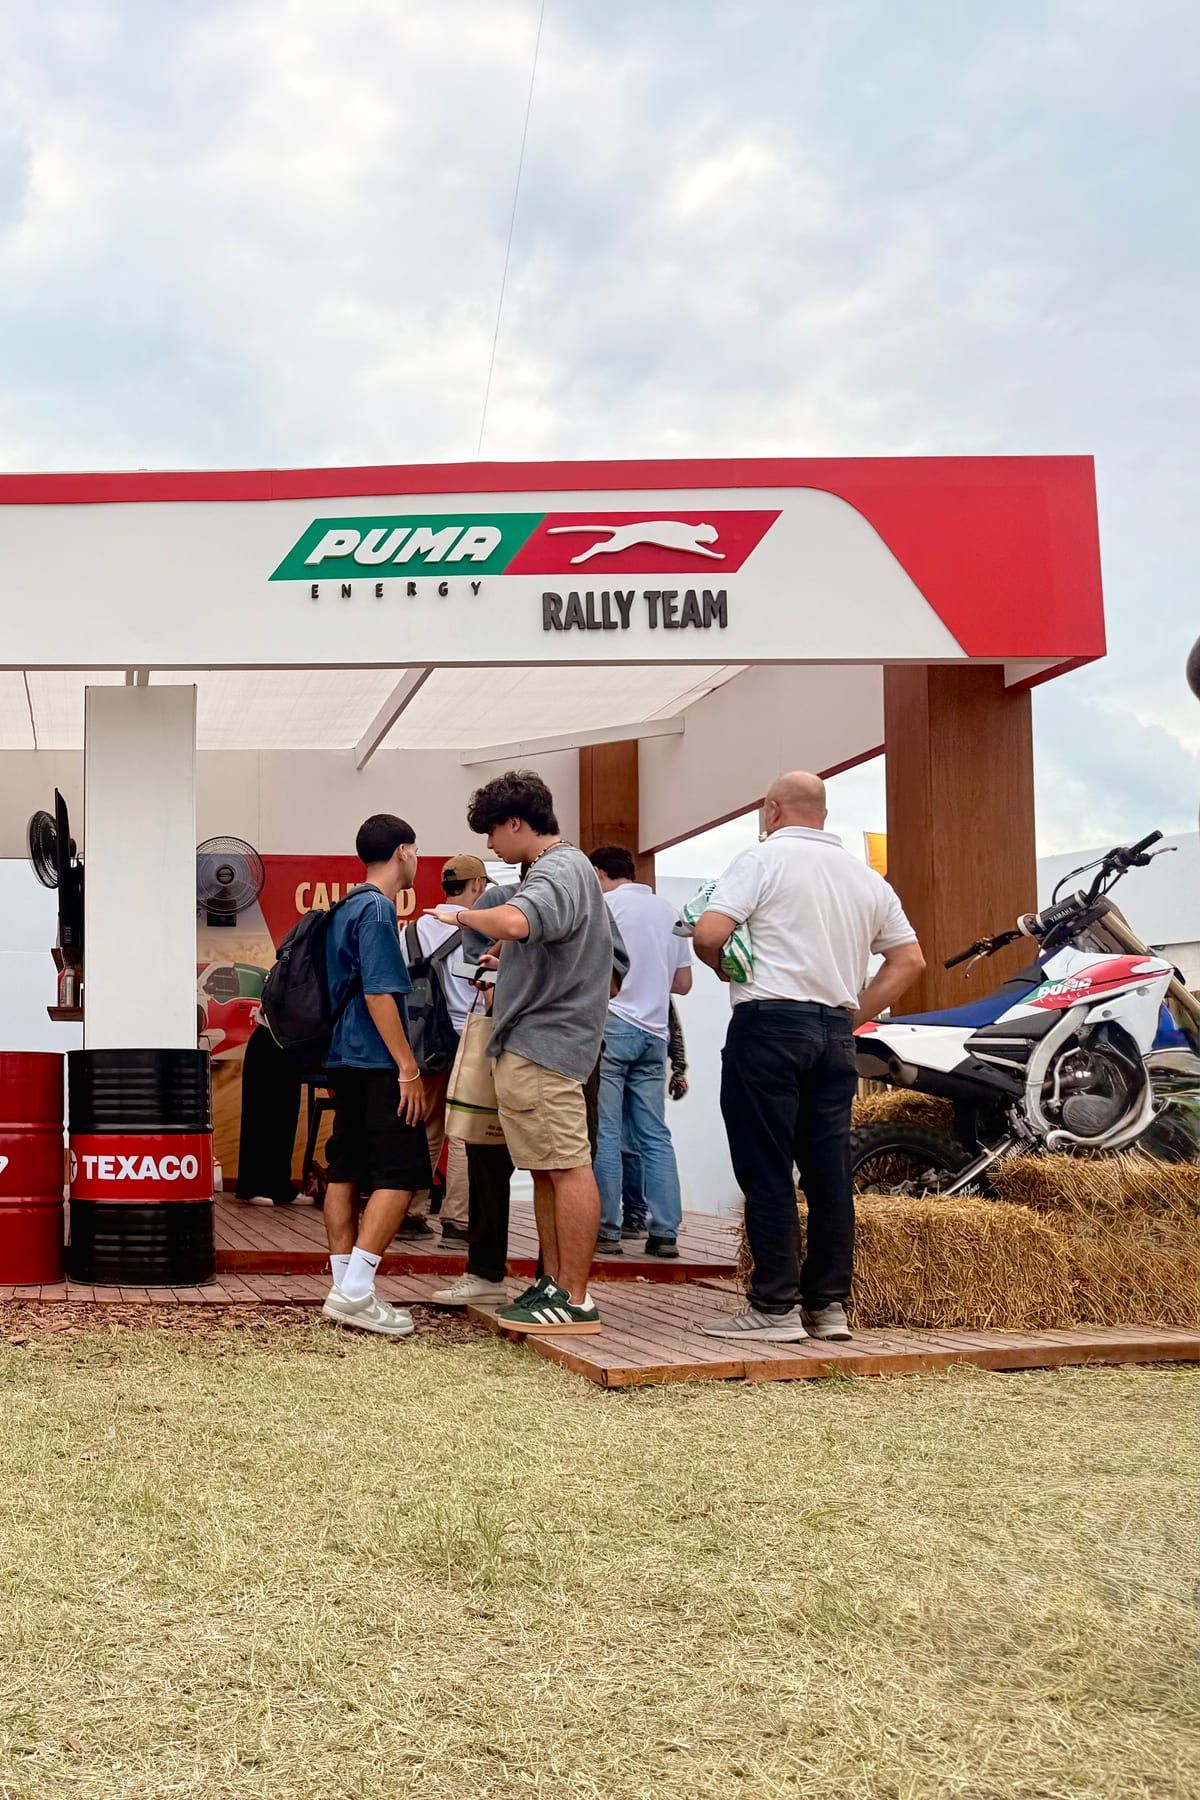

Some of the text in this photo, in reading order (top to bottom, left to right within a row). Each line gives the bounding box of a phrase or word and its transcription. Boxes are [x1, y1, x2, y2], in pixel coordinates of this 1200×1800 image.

[304, 526, 503, 567] PUMA
[310, 580, 483, 600] ENERGY
[543, 589, 729, 632] RALLY TEAM
[1050, 906, 1075, 923] YAMAHA
[82, 1154, 199, 1181] TEXACO
